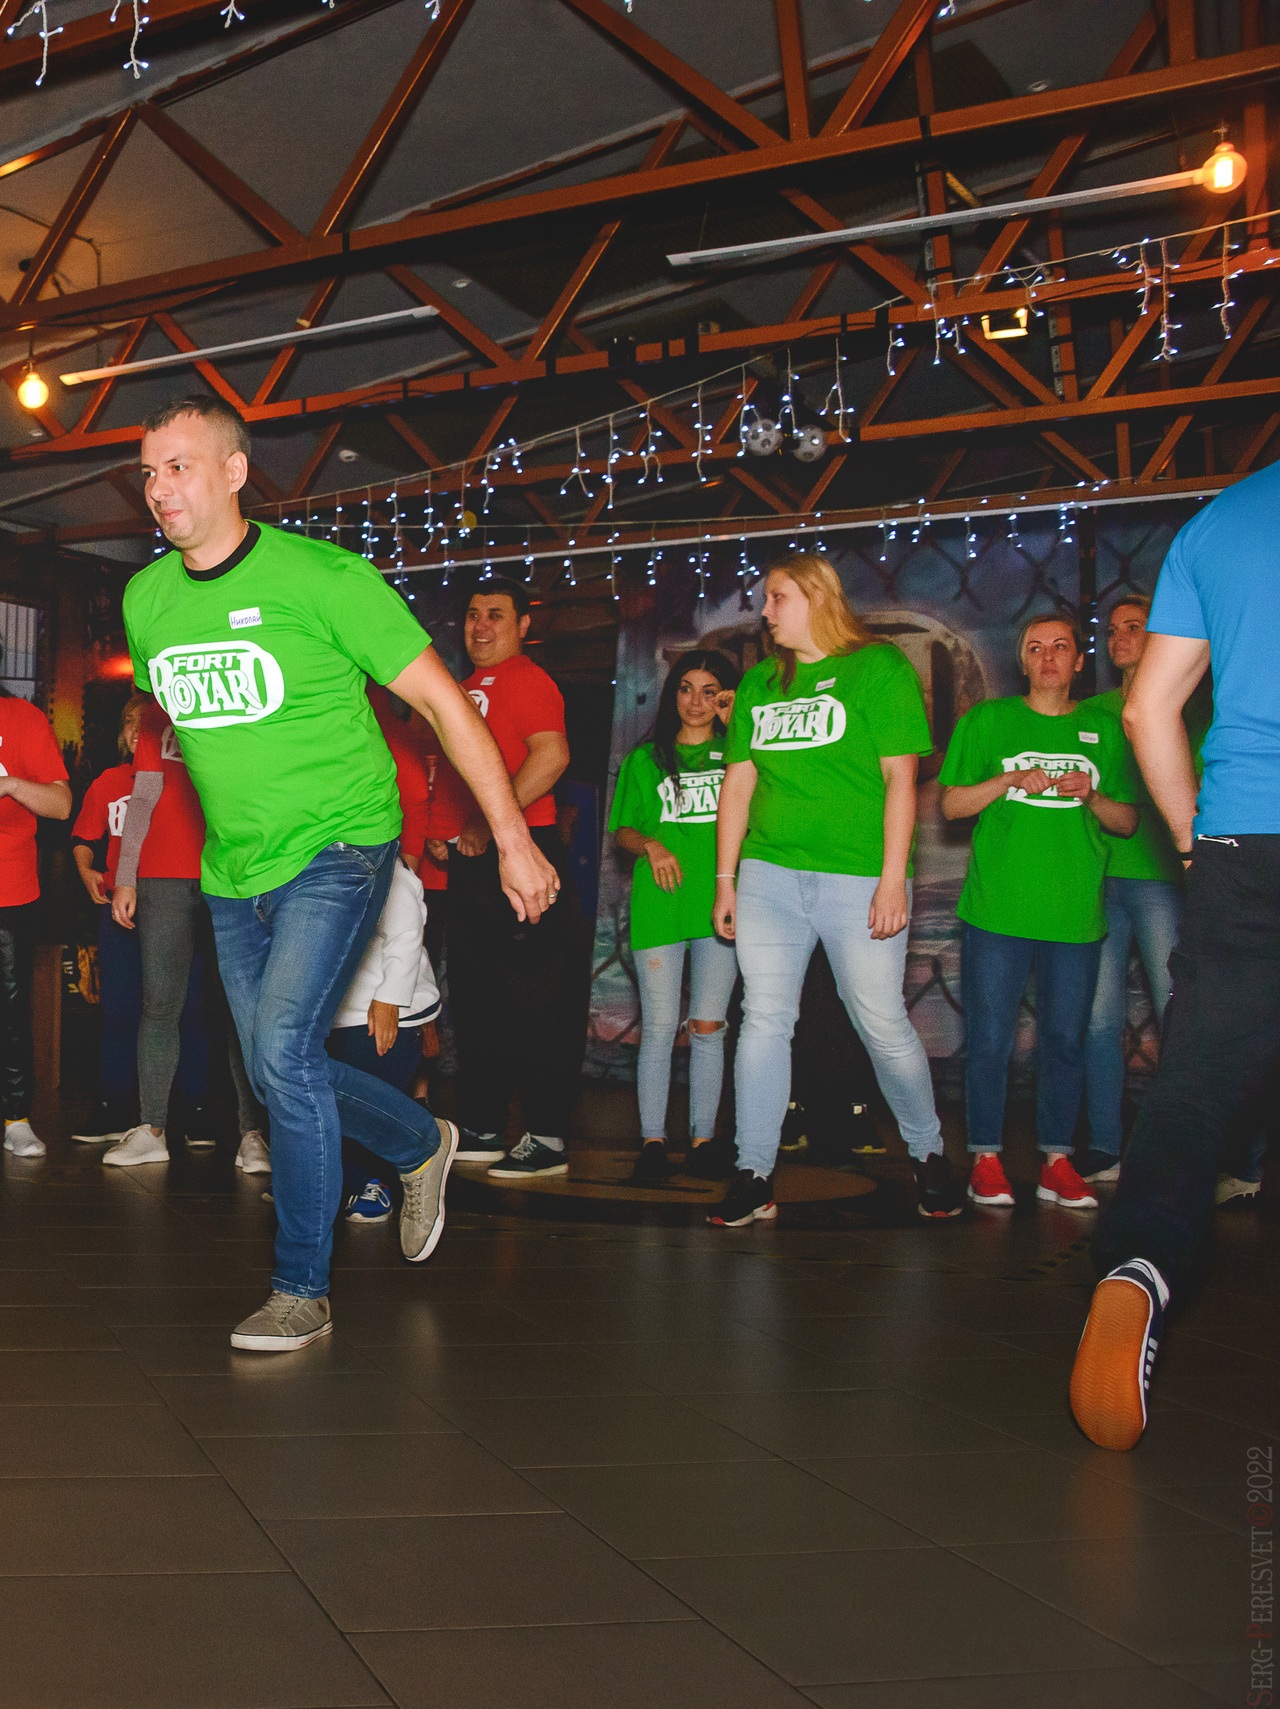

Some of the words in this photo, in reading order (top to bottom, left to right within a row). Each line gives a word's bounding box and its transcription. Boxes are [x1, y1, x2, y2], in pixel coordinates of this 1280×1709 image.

[173, 652, 238, 673] FORT
[148, 651, 284, 721] BOYARD
[773, 703, 816, 717] FORT
[750, 701, 847, 748] BOYARD
[1028, 757, 1079, 771] FORT
